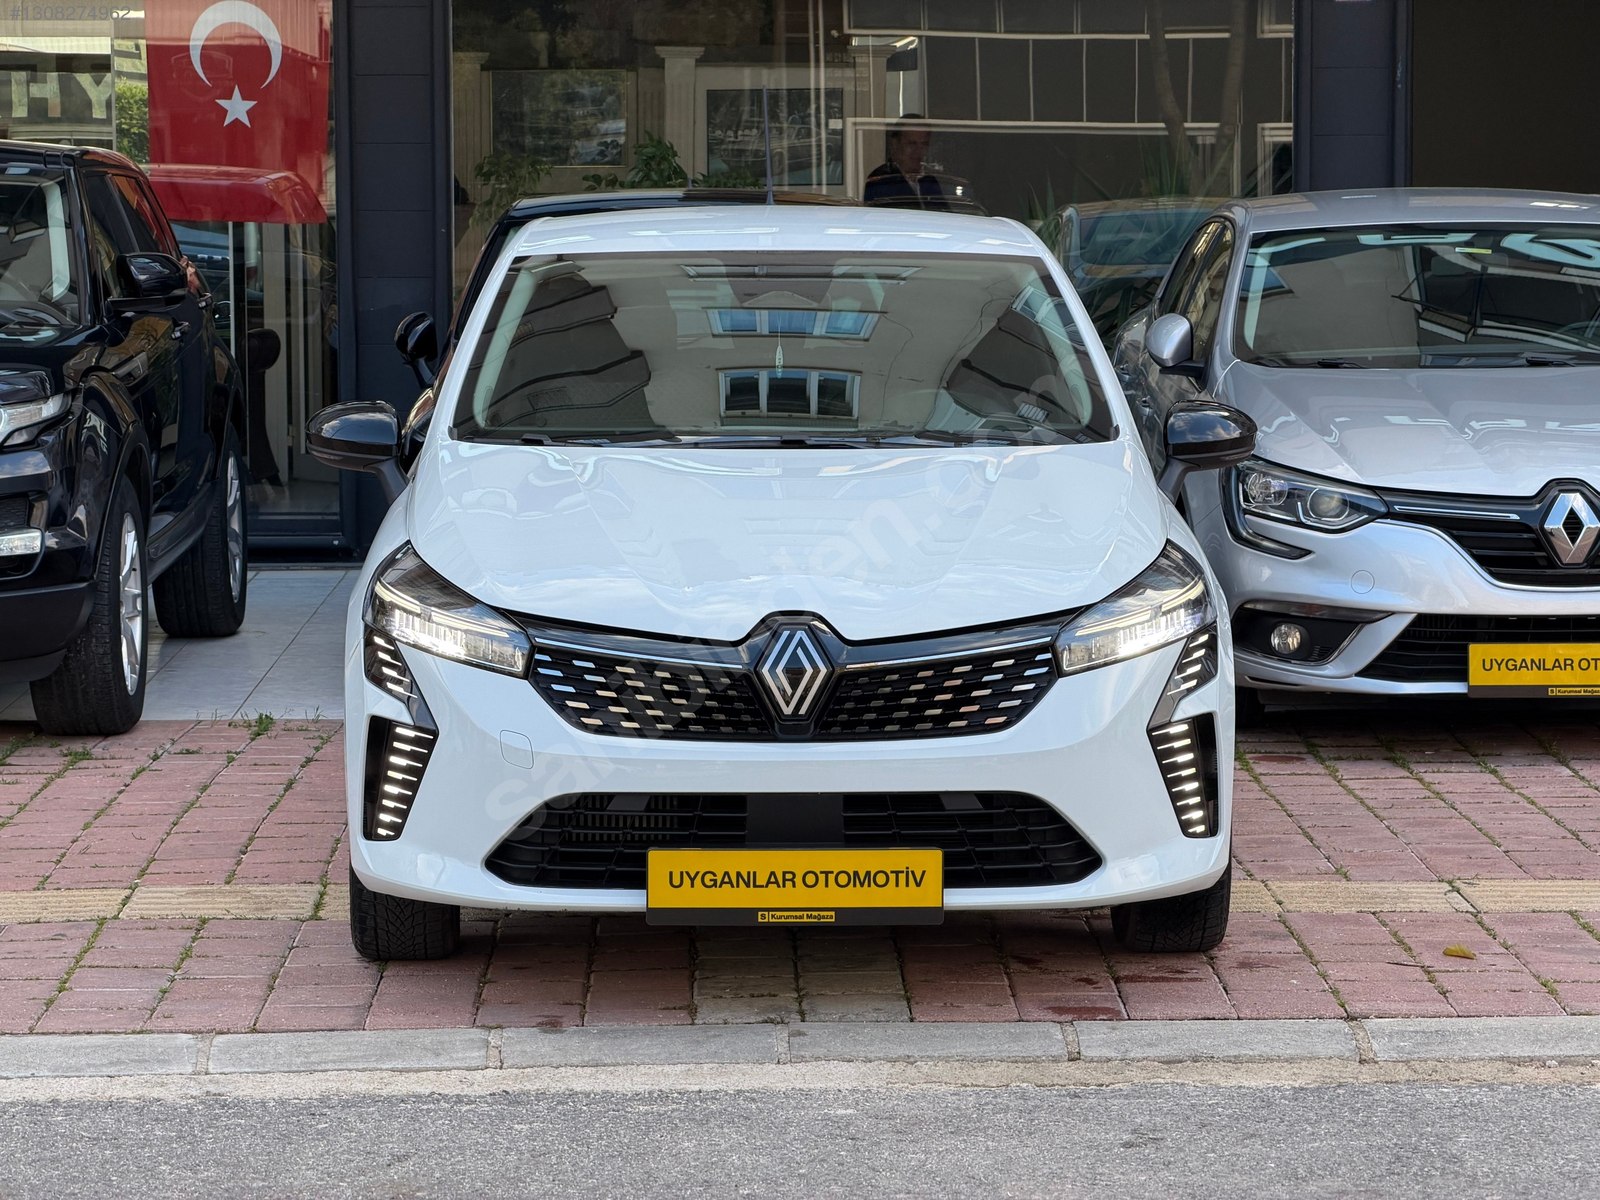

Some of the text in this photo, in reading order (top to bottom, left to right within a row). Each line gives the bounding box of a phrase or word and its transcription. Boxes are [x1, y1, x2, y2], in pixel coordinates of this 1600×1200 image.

[1482, 658, 1574, 672] UYGANLAR
[668, 866, 926, 889] UYGANLAR OTOMOTİV
[806, 913, 834, 921] Mağaza
